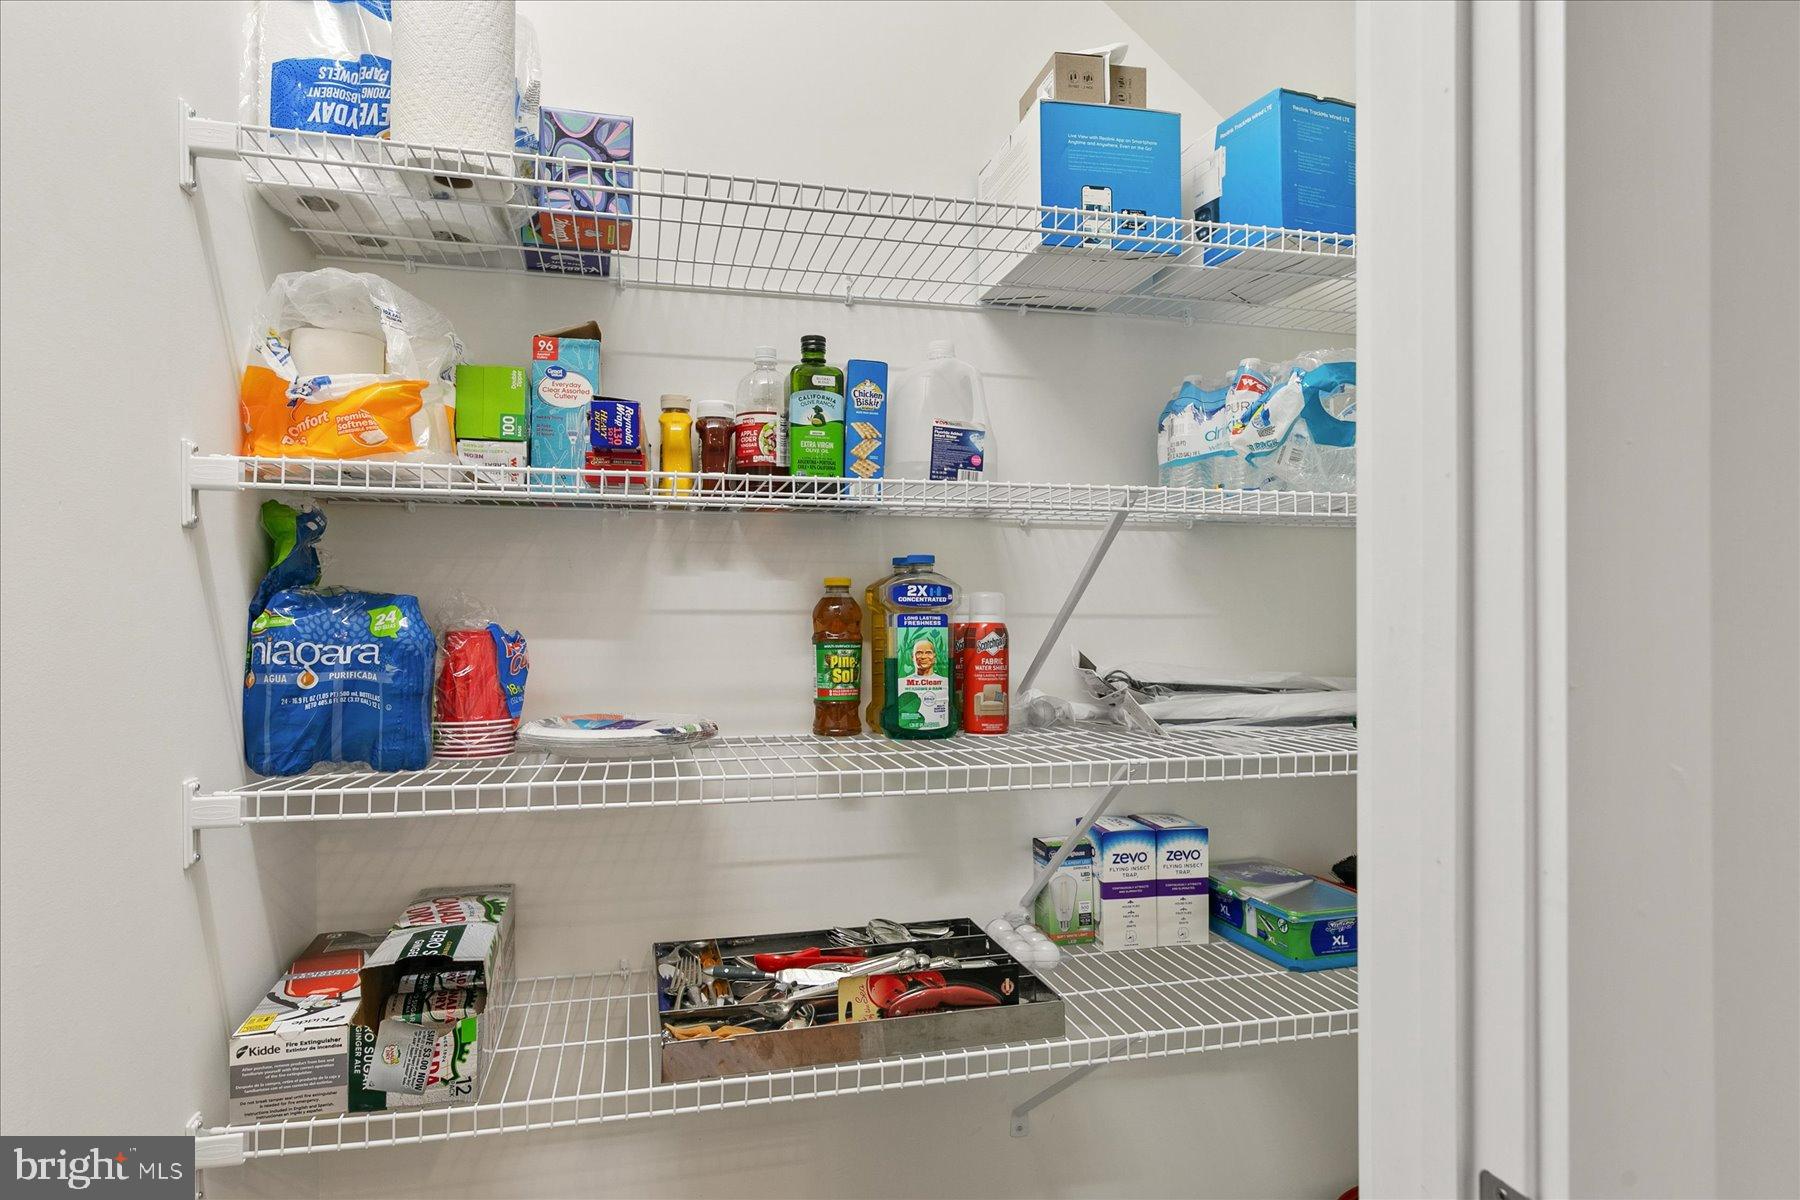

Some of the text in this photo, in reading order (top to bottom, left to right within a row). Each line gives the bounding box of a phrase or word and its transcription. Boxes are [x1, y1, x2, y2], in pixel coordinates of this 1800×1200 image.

[360, 67, 391, 82] PAPE
[538, 340, 554, 351] 96
[798, 394, 836, 404] CALIFORNIA
[853, 390, 883, 400] Chicken
[816, 400, 836, 409] RANCH
[856, 398, 879, 407] Biskit
[614, 403, 625, 427] Wrap
[502, 416, 515, 436] 100
[600, 410, 608, 439] HEAVY
[622, 406, 634, 446] Reynolds
[608, 437, 613, 445] FT
[614, 427, 622, 446] 130
[800, 440, 817, 448] EXTRA
[907, 585, 927, 596] 2X
[376, 612, 398, 626] 24
[251, 638, 380, 677] niagara
[830, 655, 855, 668] Pine
[264, 671, 378, 683] AGUA PURIFICADA
[832, 668, 854, 683] Sol
[507, 684, 518, 696] 18
[360, 692, 380, 701] BOTELLAS
[305, 702, 318, 710] NETO
[1112, 852, 1147, 864] zevo
[1166, 849, 1201, 861] zevo
[406, 906, 435, 925] DRY
[1220, 904, 1231, 916] XL
[428, 930, 448, 948] ZERO
[1268, 935, 1277, 946] XL
[1332, 935, 1348, 946] XL
[300, 1037, 342, 1046] Extinguisher
[354, 1026, 362, 1057] GINGER
[249, 1046, 281, 1058] Kidde
[414, 1030, 435, 1091] SAVE $3.00 NOW
[456, 1076, 472, 1096] 12
